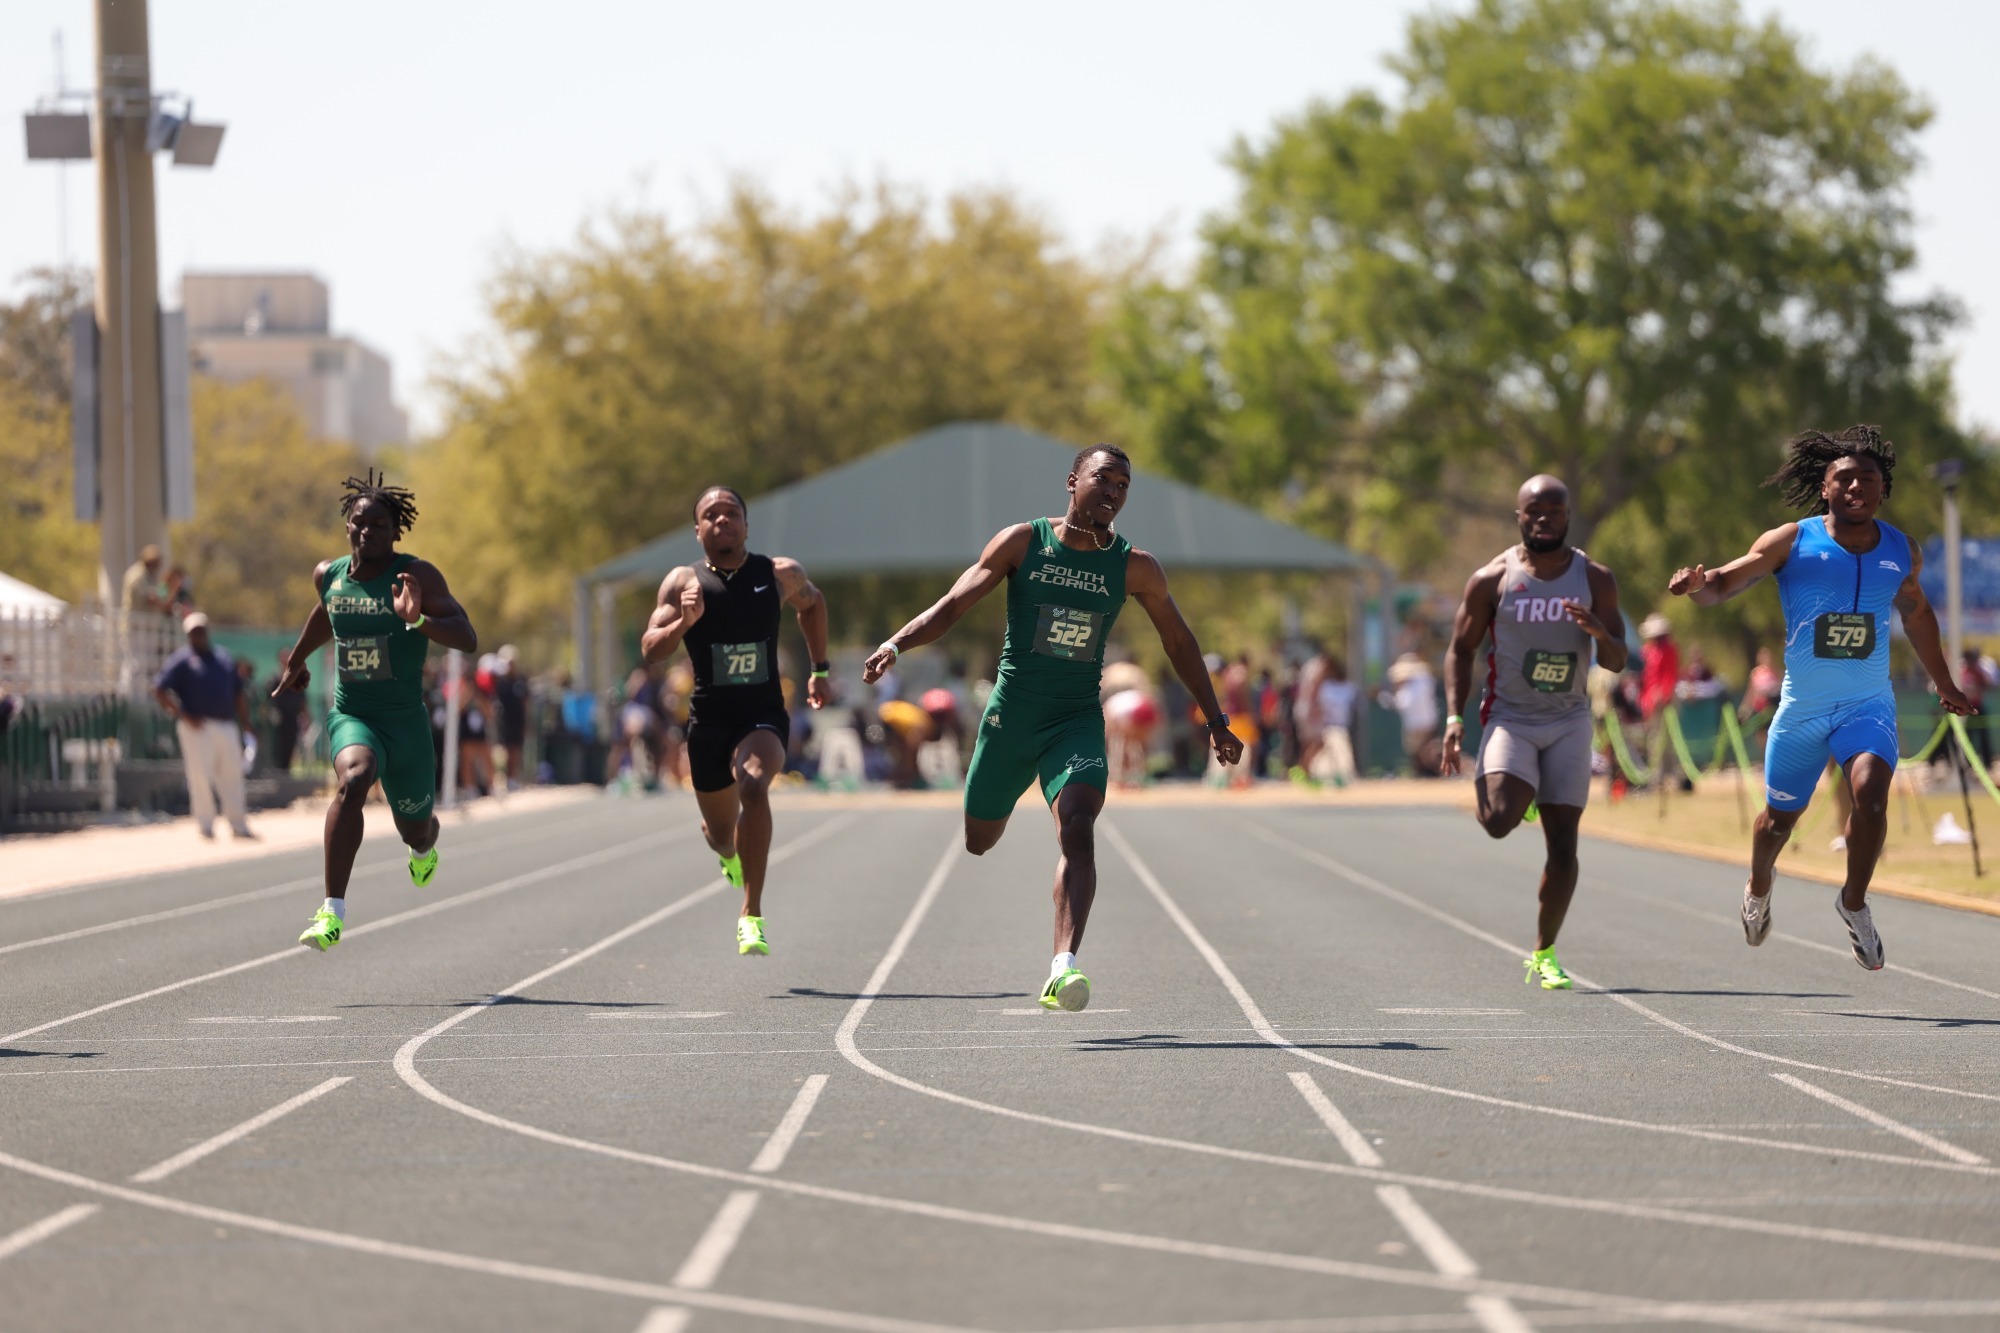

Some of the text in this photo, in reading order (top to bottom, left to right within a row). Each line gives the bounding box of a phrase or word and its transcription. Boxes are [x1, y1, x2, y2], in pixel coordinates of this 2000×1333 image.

[1028, 571, 1110, 597] FLORIDA
[1041, 563, 1105, 585] SOUTH
[327, 603, 393, 615] FLORIDA
[331, 595, 385, 607] SOUTH
[1046, 620, 1092, 648] 522
[1826, 625, 1867, 647] 579
[347, 649, 380, 671] 534
[728, 653, 757, 675] 713
[1532, 662, 1570, 683] 663
